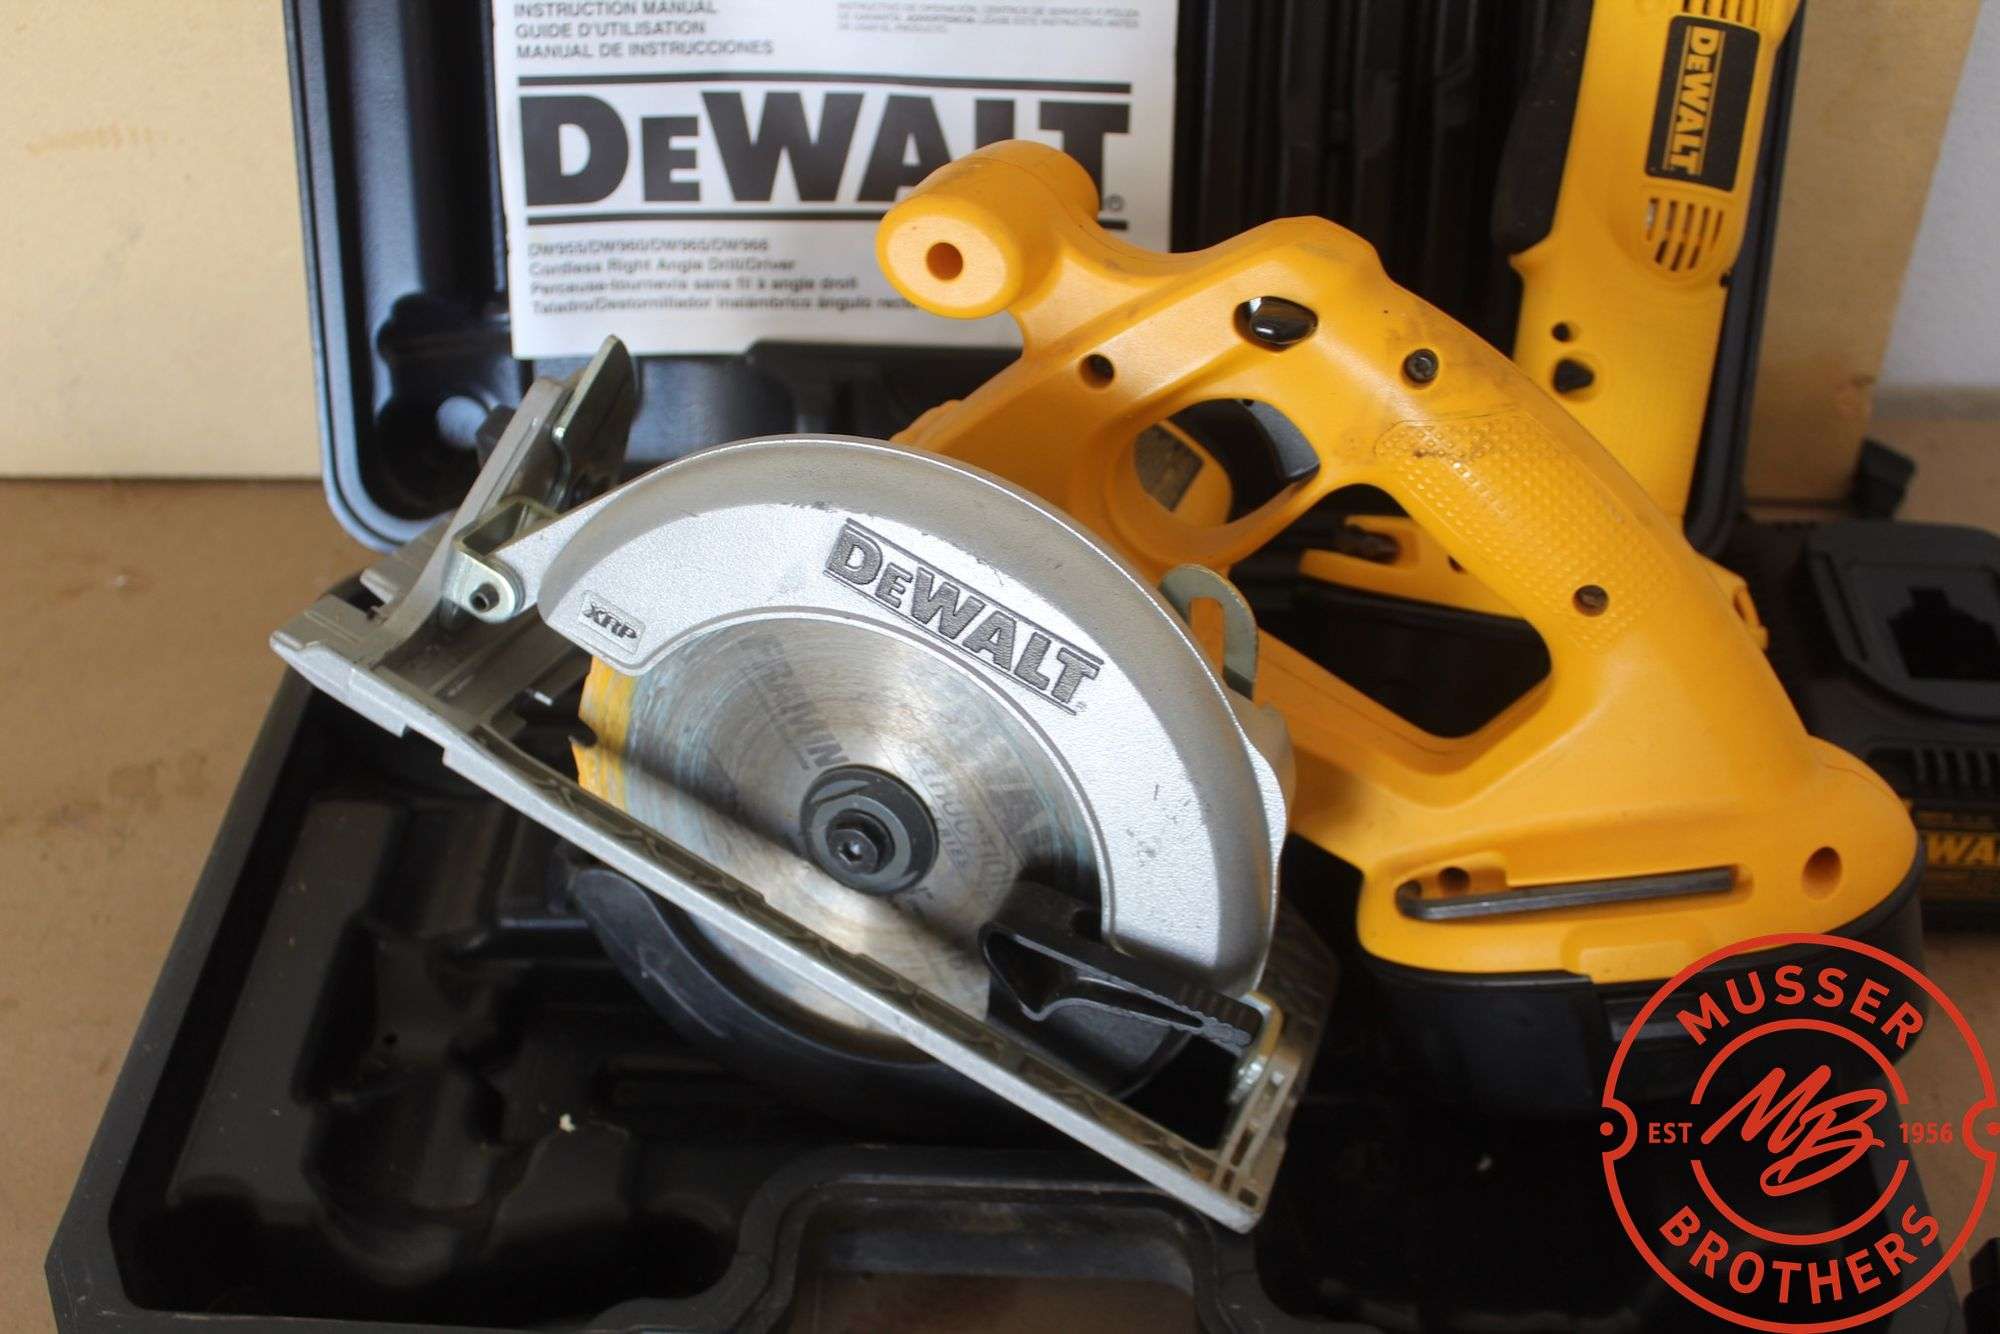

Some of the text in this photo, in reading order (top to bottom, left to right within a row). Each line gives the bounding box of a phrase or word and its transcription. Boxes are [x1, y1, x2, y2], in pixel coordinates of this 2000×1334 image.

[514, 0, 718, 17] INSTRUCTION MANUAL
[516, 20, 706, 38] GUIDE D'UTILISATION
[517, 40, 775, 58] MANUAL DE INSTRUCCIONES
[1669, 25, 1722, 176] DEWALT
[530, 256, 796, 276] Cordless Right Angle Drill/Driver
[771, 277, 815, 292] angle
[820, 275, 858, 289] droit
[582, 602, 637, 639] XRP
[826, 527, 1100, 705] DEWALT
